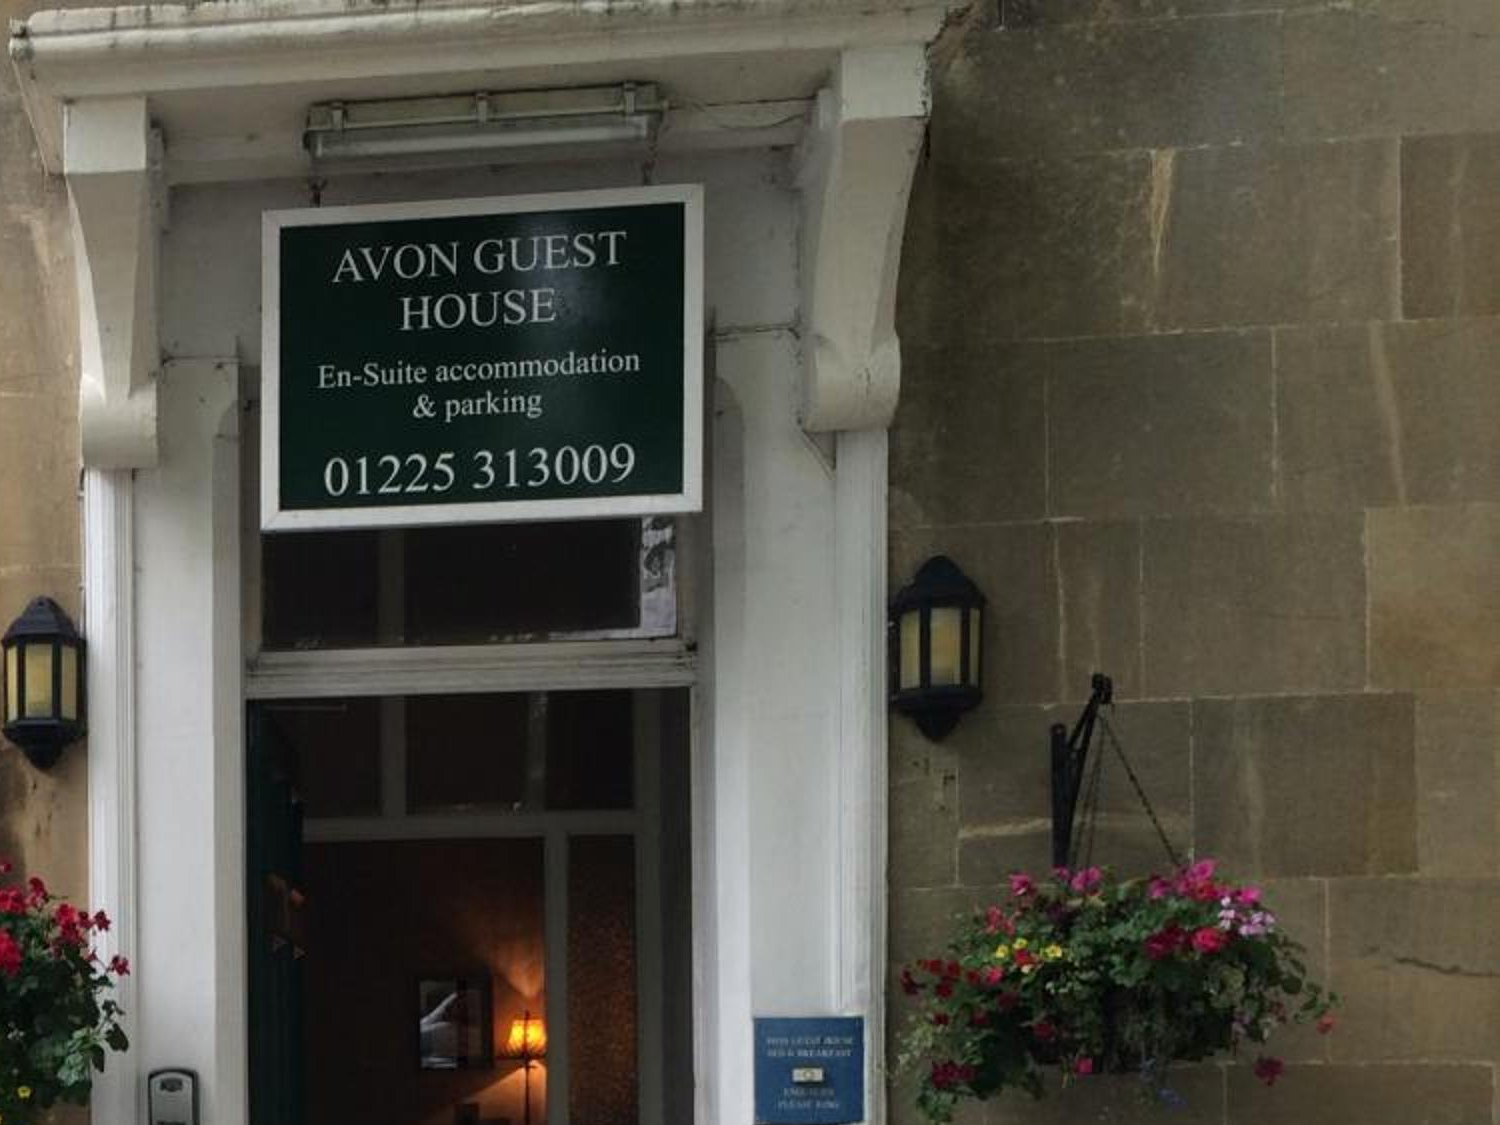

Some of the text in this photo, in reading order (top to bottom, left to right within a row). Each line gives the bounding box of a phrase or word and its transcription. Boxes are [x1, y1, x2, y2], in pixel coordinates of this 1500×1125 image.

[332, 230, 628, 284] AVON GUEST
[400, 288, 558, 331] HOUSE
[317, 348, 641, 390] En-Suite accommodation
[412, 388, 543, 423] & parking
[323, 442, 636, 498] 01225 313009
